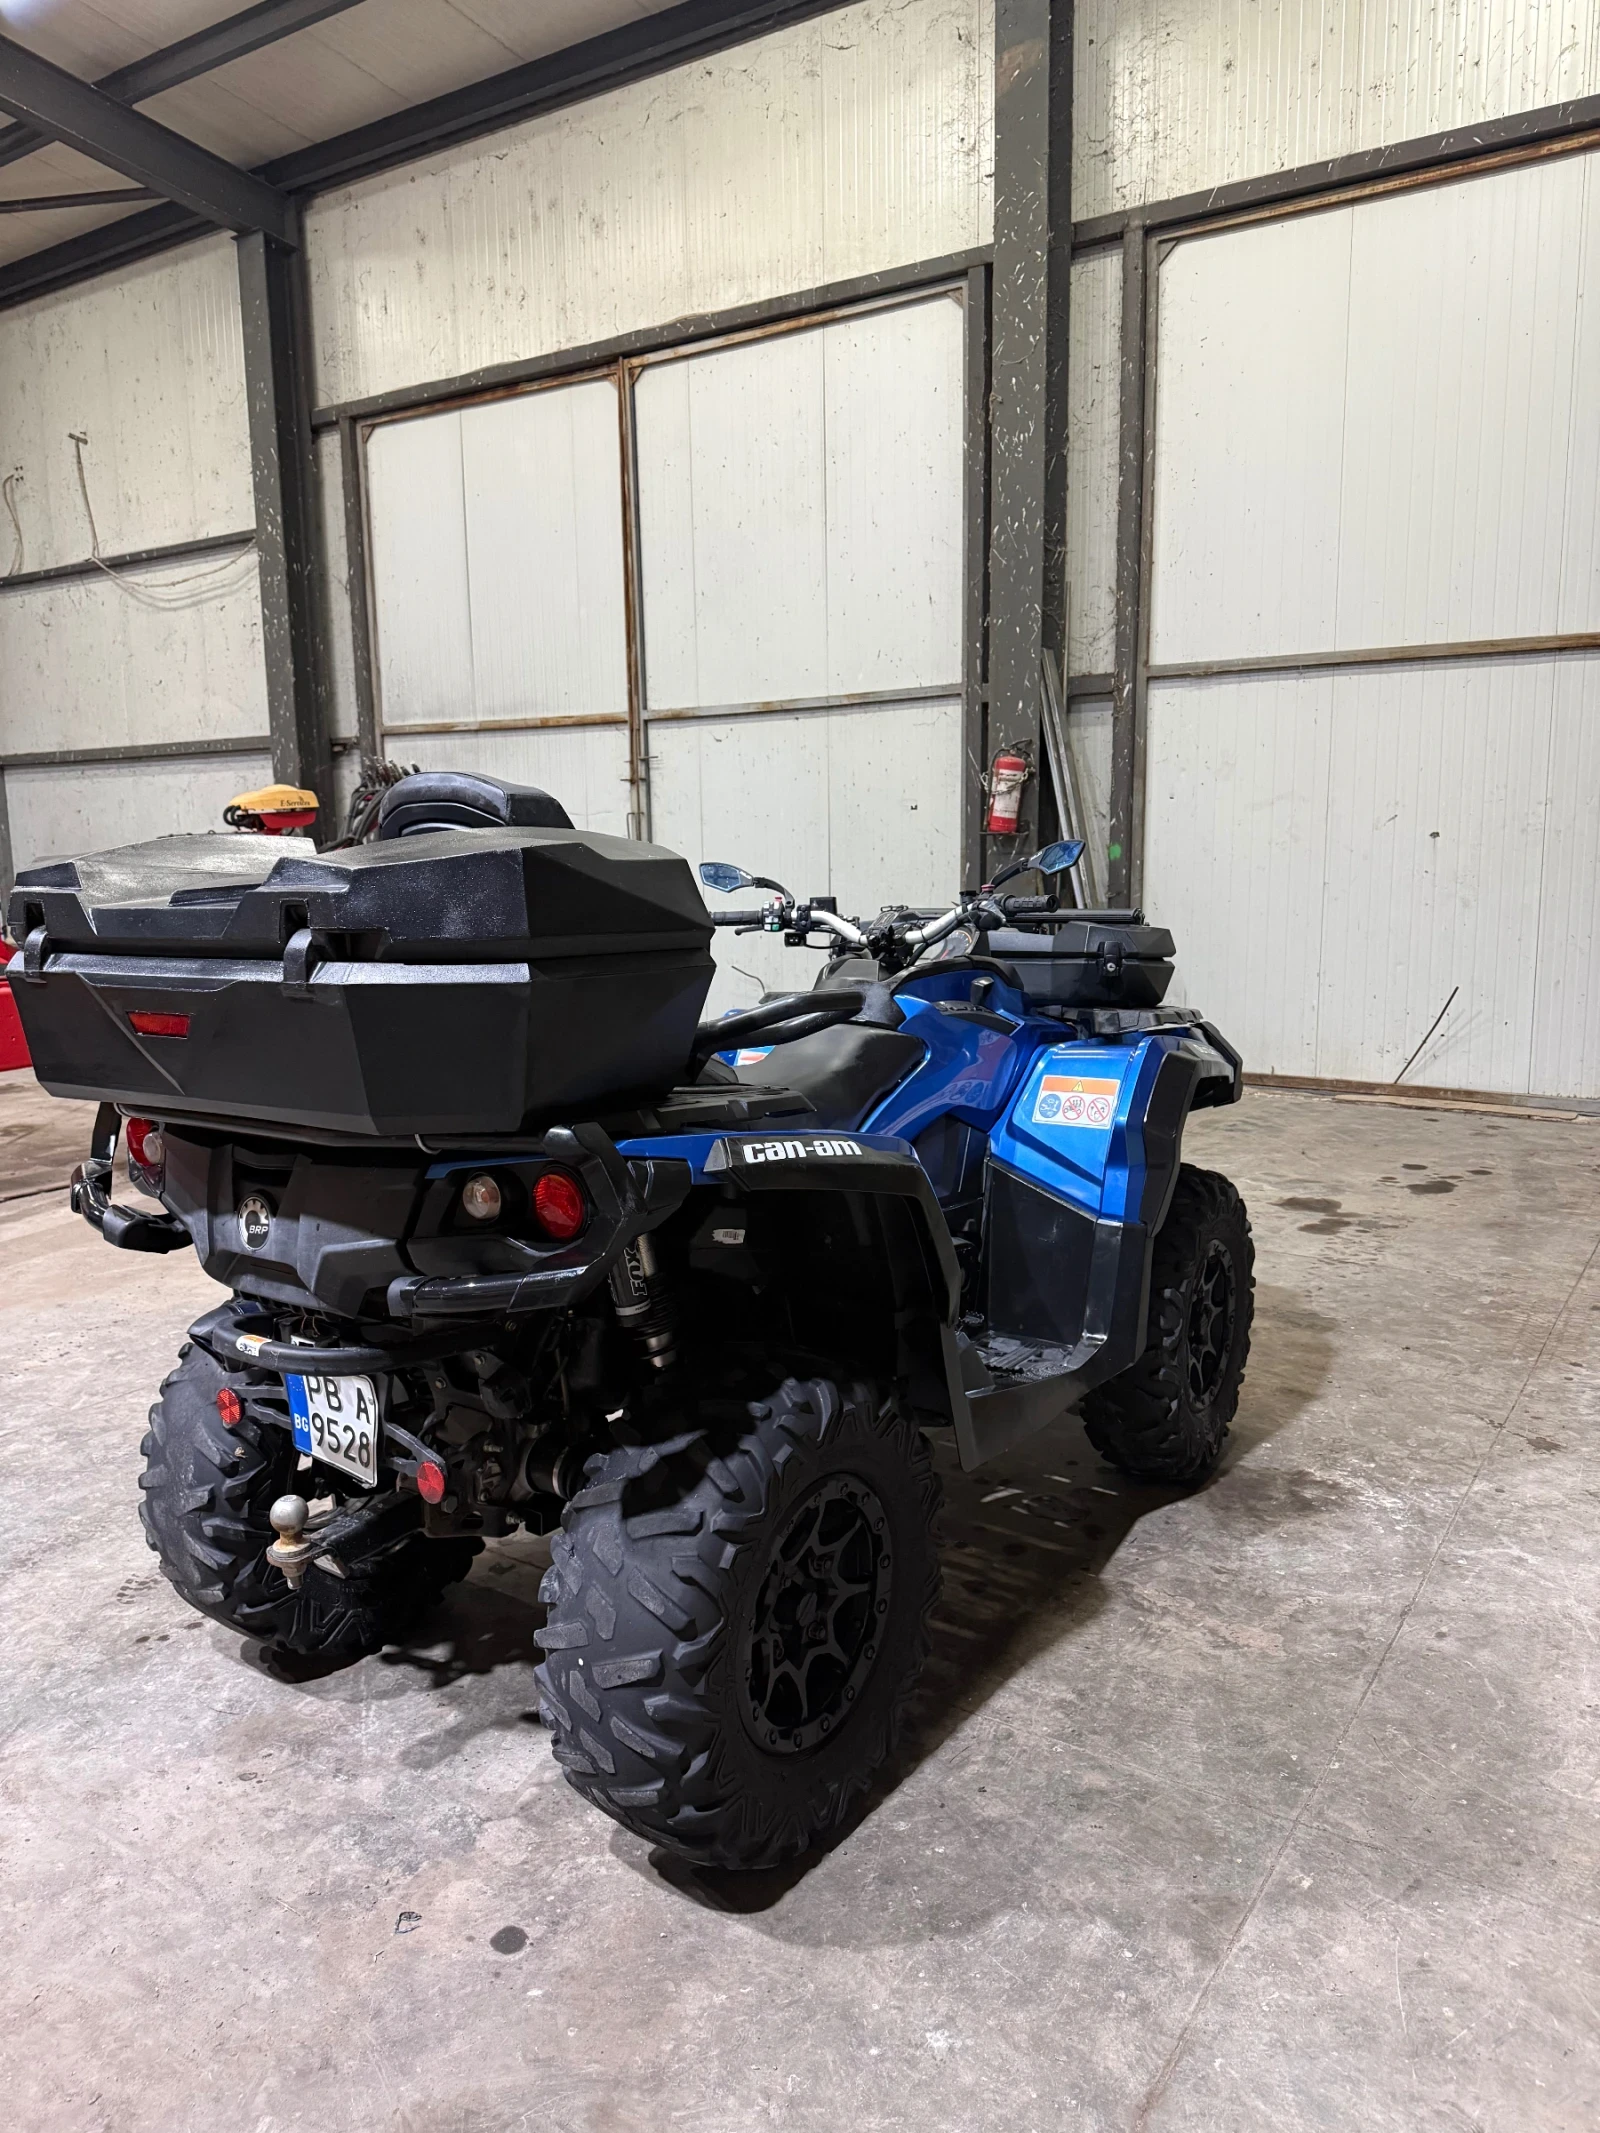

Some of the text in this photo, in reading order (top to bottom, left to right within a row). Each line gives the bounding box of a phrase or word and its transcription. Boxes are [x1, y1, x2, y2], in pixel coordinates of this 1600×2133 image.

[742, 1139, 862, 1164] can-am
[248, 1225, 269, 1235] BRP
[623, 1241, 648, 1296] FOX
[305, 1375, 371, 1425] PB A
[294, 1413, 309, 1432] BG
[311, 1412, 371, 1468] 9528
